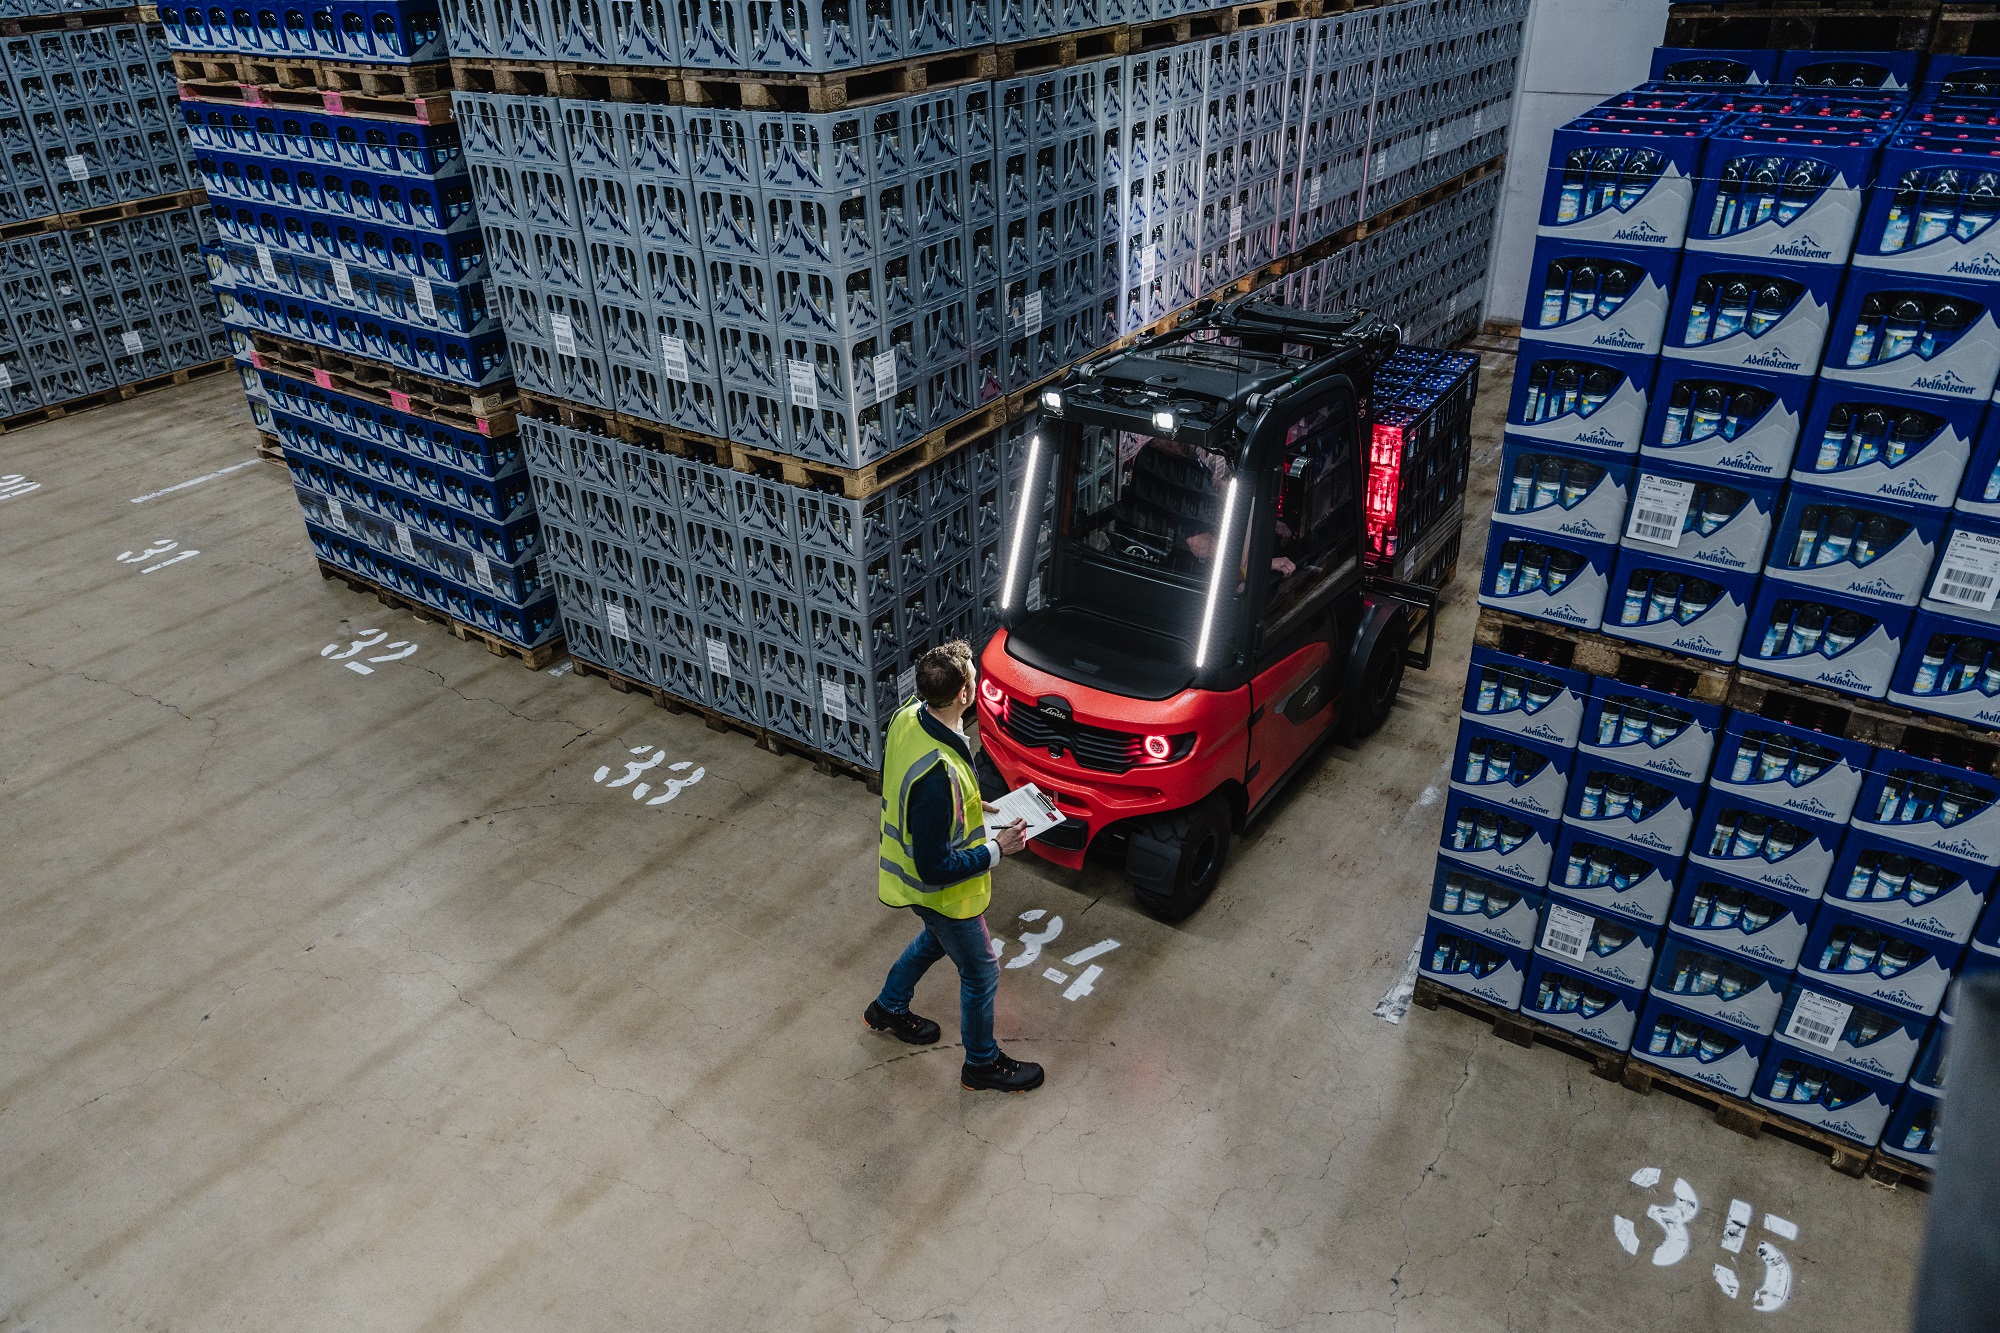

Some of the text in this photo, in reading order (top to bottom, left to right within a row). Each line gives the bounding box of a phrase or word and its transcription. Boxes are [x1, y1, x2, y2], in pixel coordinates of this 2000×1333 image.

[1613, 229, 1668, 243] Adelholzener
[1770, 244, 1832, 259] Adelholzener
[1947, 261, 2000, 277] Adelholze
[1592, 335, 1645, 350] Adelholzener
[1742, 354, 1801, 370] Adelholzener
[1910, 377, 1976, 395] Adelholzener
[1573, 433, 1624, 448] Adelholzener
[1717, 457, 1773, 474] Adelholzener
[1659, 478, 1683, 488] 0000375
[1876, 484, 1939, 502] Adelholzener
[1558, 523, 1606, 540] Adelholzener
[116, 539, 200, 574] 31
[1693, 551, 1746, 568] Adelholzener
[1846, 582, 1905, 601] Adelholzener
[1541, 608, 1588, 624] Adelholzener
[320, 628, 418, 675] 32
[1672, 638, 1722, 656] Adelholzener
[1816, 672, 1873, 692] Adelholzener
[1040, 707, 1067, 720] Linde
[1521, 726, 1565, 743] Adelholzener
[593, 745, 705, 805] 33
[1644, 760, 1693, 778] Adelholzener
[1507, 797, 1550, 815] Adelholzener
[1783, 799, 1837, 819] Adelholzener
[1626, 833, 1672, 851] Adelholzener
[1931, 840, 1989, 861] Adelholzener
[1495, 865, 1536, 882] Adelholzener
[1759, 874, 1810, 894] Adelholzener
[1610, 902, 1654, 921] Adelholzener
[1483, 927, 1522, 946] Adelholzener
[1900, 917, 1956, 939] Adelholzener
[990, 909, 1121, 1002] 34
[1737, 944, 1785, 965] Adelholzener
[1593, 966, 1636, 986] Adelholzener
[1471, 987, 1509, 1005] Adelholzener
[1871, 989, 1924, 1011] Adelholzener
[1714, 1010, 1761, 1031] Adelholzener
[1577, 1026, 1618, 1046] Adelholzener
[1844, 1056, 1895, 1078] Adelholzener
[1693, 1072, 1738, 1092] Adelholzener
[1818, 1119, 1867, 1141] Adelholzener
[1613, 1167, 1800, 1311] 35
